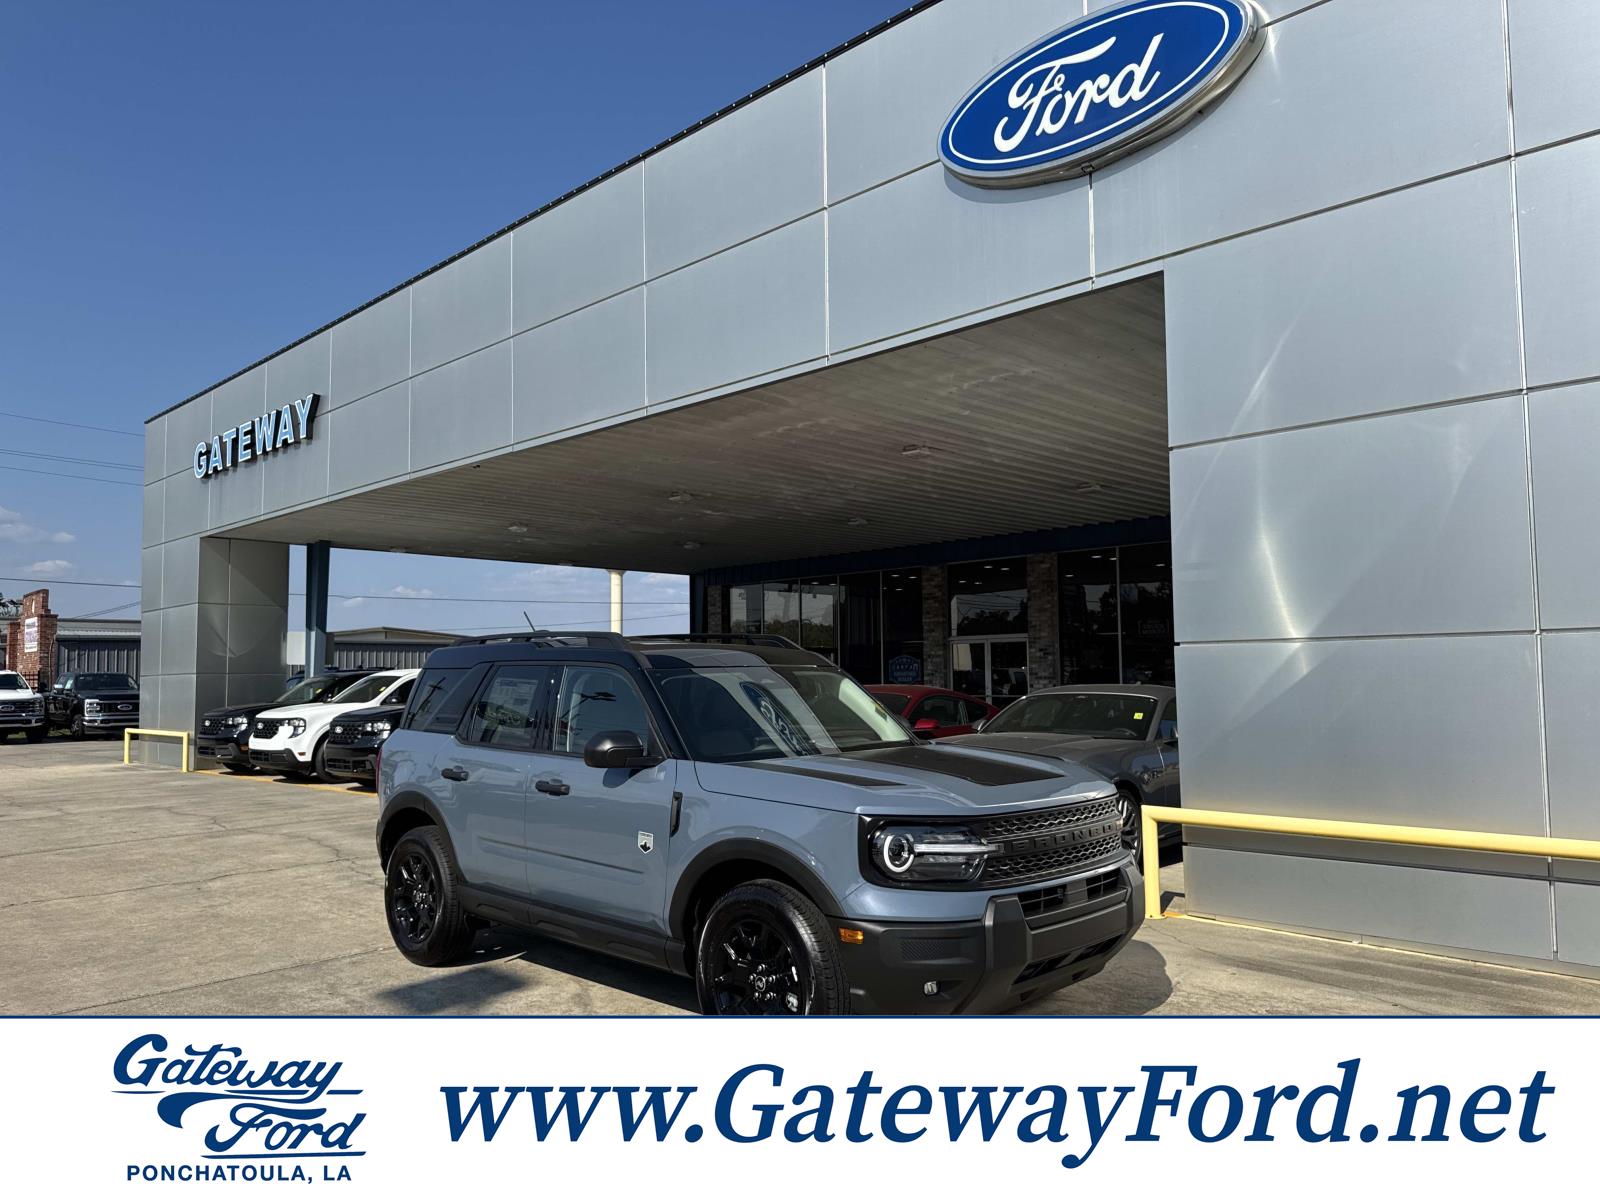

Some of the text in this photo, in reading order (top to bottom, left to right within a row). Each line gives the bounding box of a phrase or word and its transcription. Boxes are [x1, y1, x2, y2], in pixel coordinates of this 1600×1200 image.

[993, 32, 1165, 152] Ford
[193, 393, 319, 479] GATEWAY
[1011, 824, 1114, 850] BRONCO
